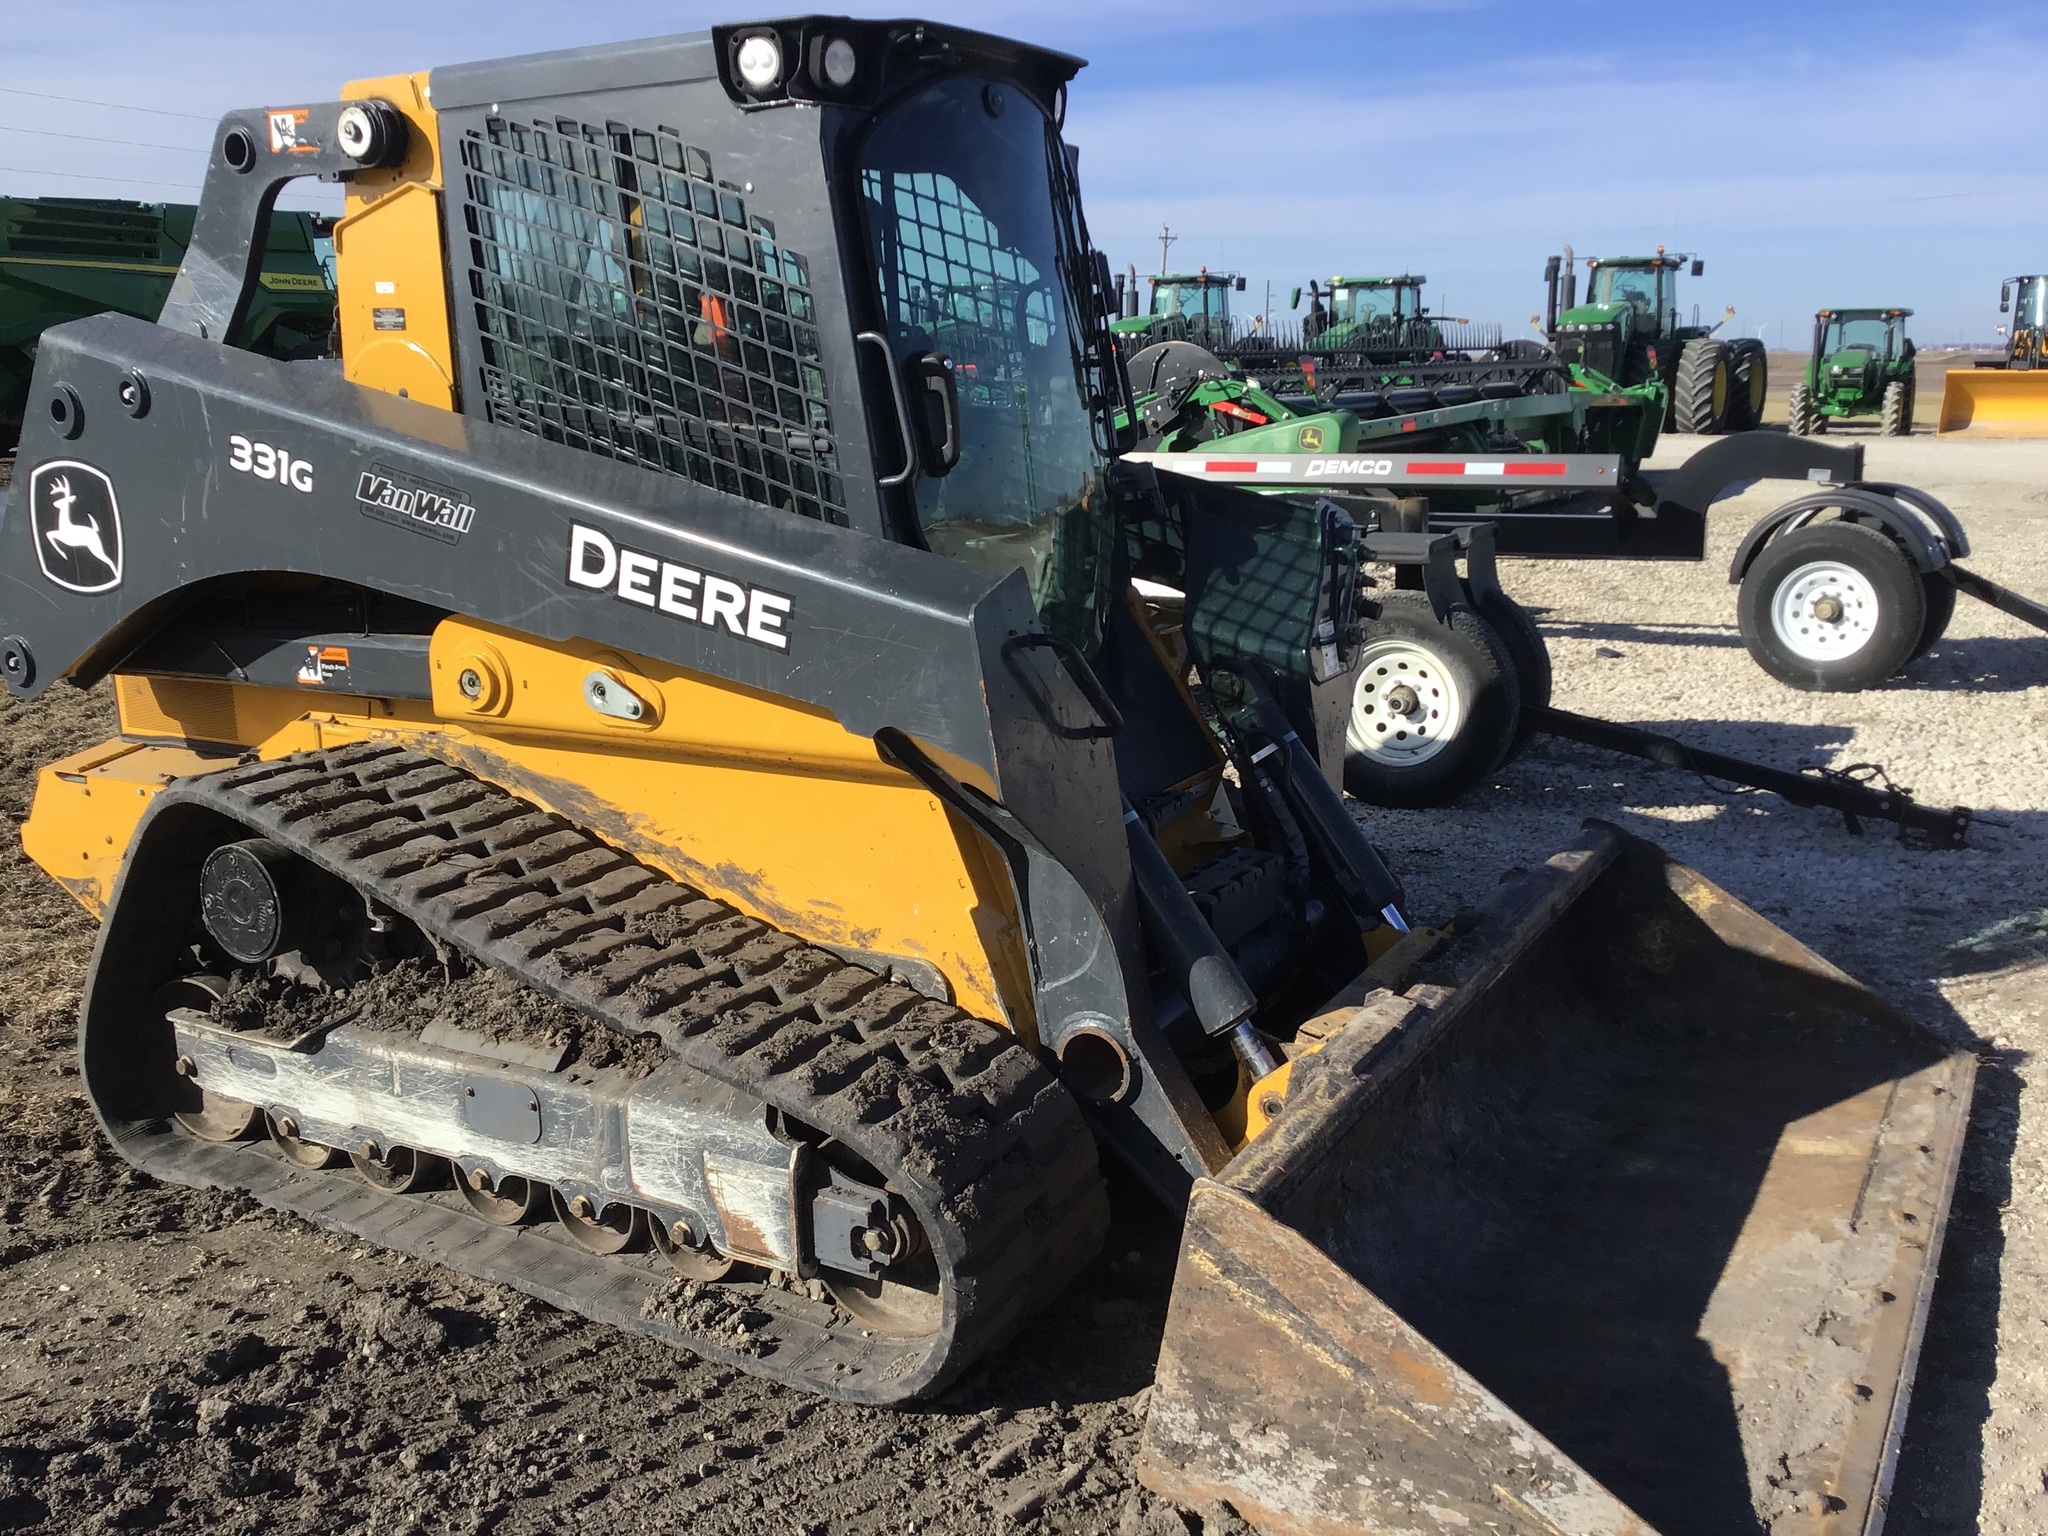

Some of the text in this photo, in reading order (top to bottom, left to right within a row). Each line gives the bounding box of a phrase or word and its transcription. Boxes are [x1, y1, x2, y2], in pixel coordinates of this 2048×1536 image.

[269, 277, 318, 286] JOHN DEERE
[229, 435, 313, 493] 331G
[1303, 460, 1393, 478] DEMCO
[568, 524, 791, 649] DEERE
